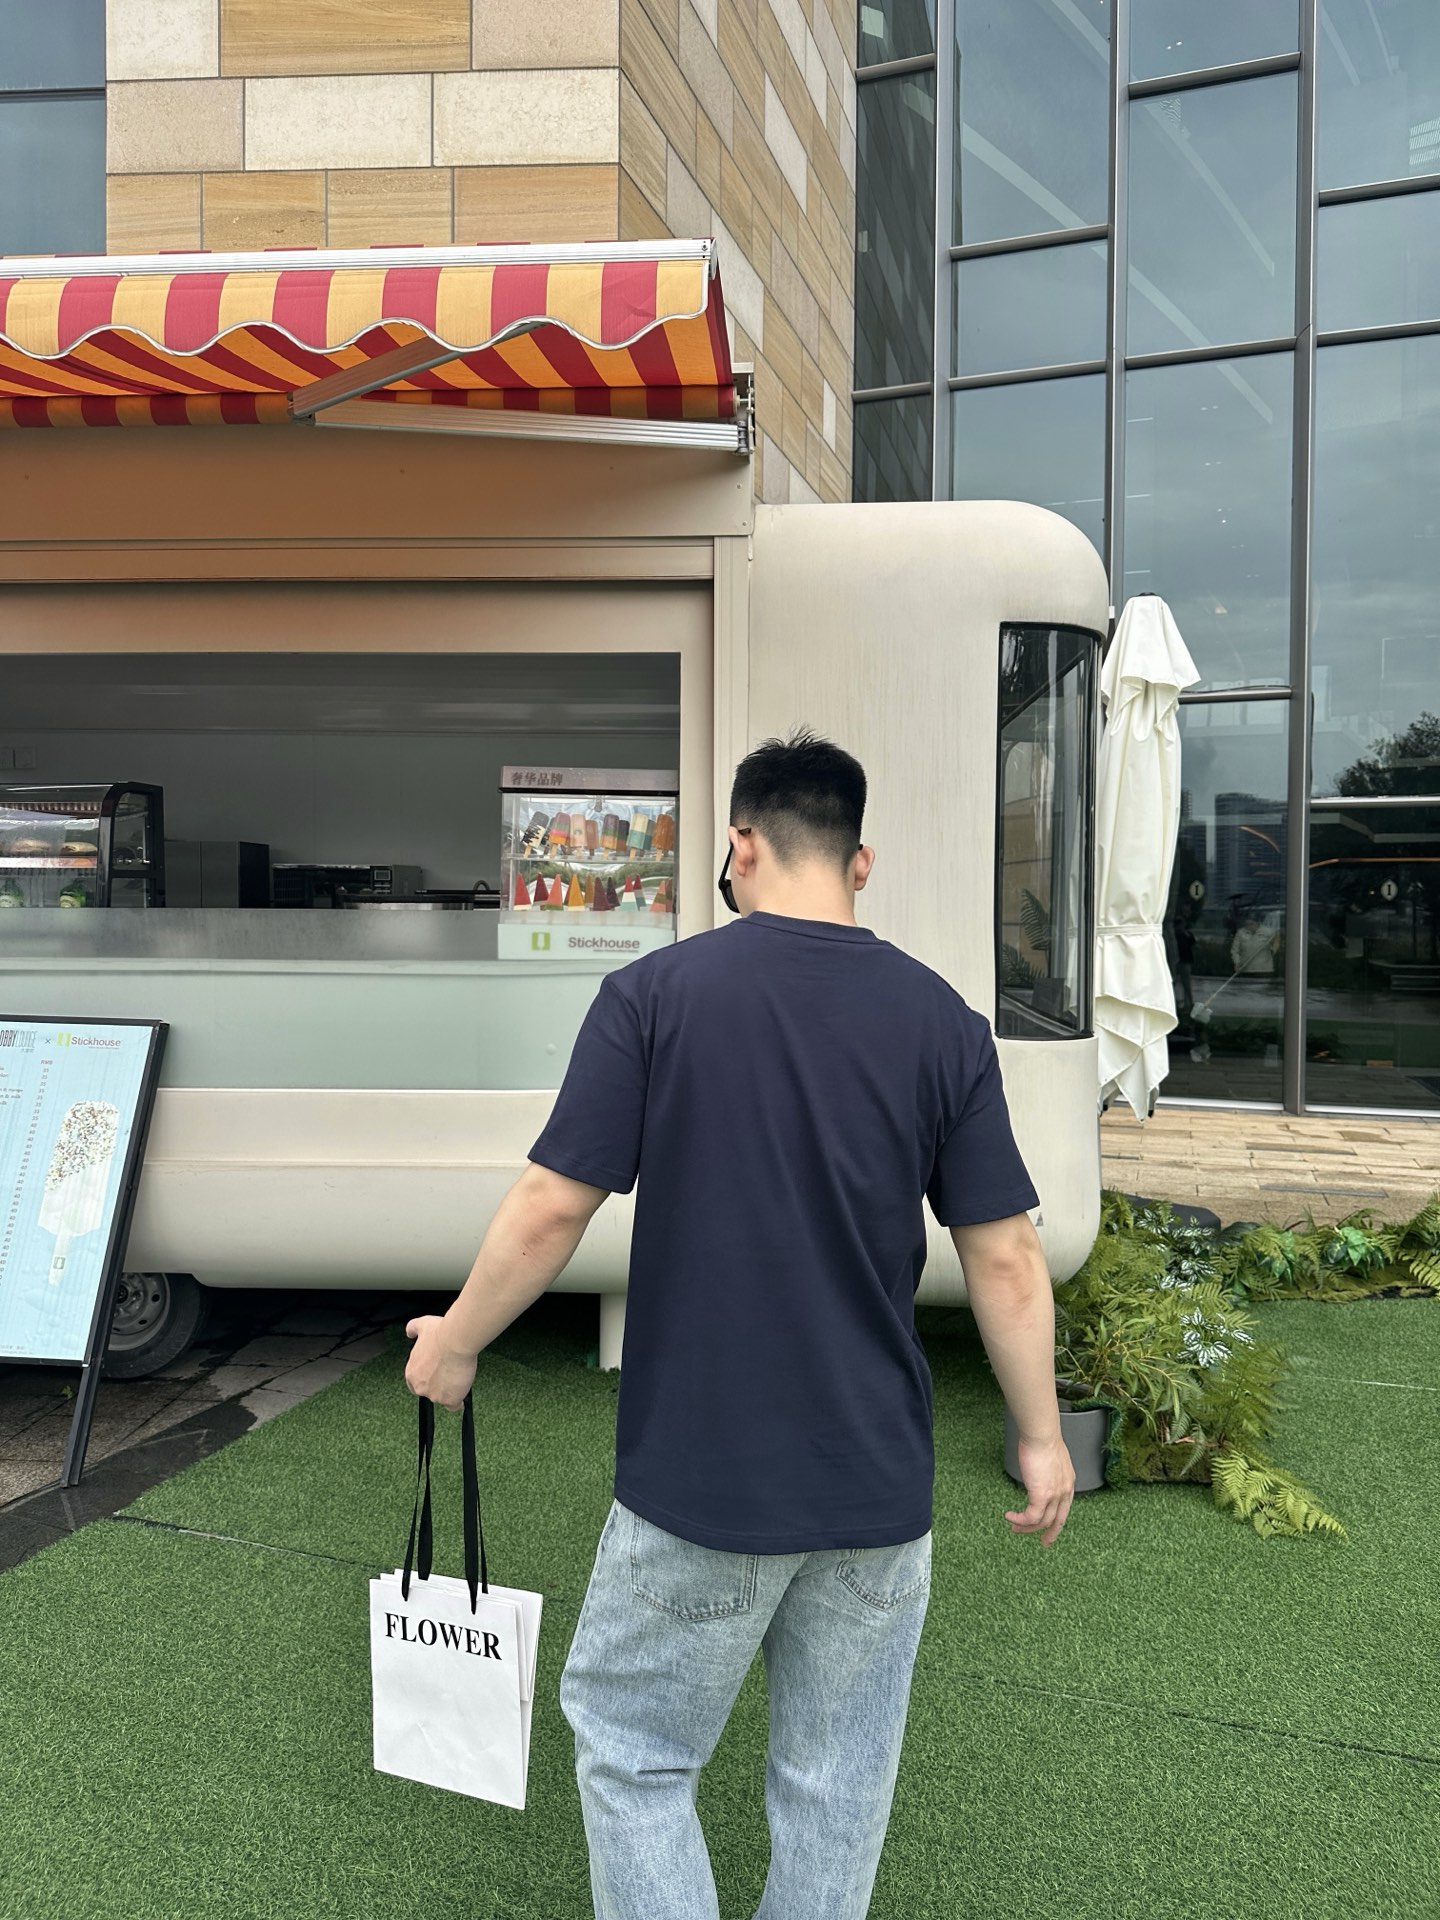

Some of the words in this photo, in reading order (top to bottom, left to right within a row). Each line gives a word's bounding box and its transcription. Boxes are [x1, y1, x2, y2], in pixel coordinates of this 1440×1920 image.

[511, 771, 563, 786] 奢华品牌
[568, 937, 641, 949] Stickhouse
[71, 1036, 121, 1047] Stickhouse
[384, 1611, 503, 1661] FLOWER
